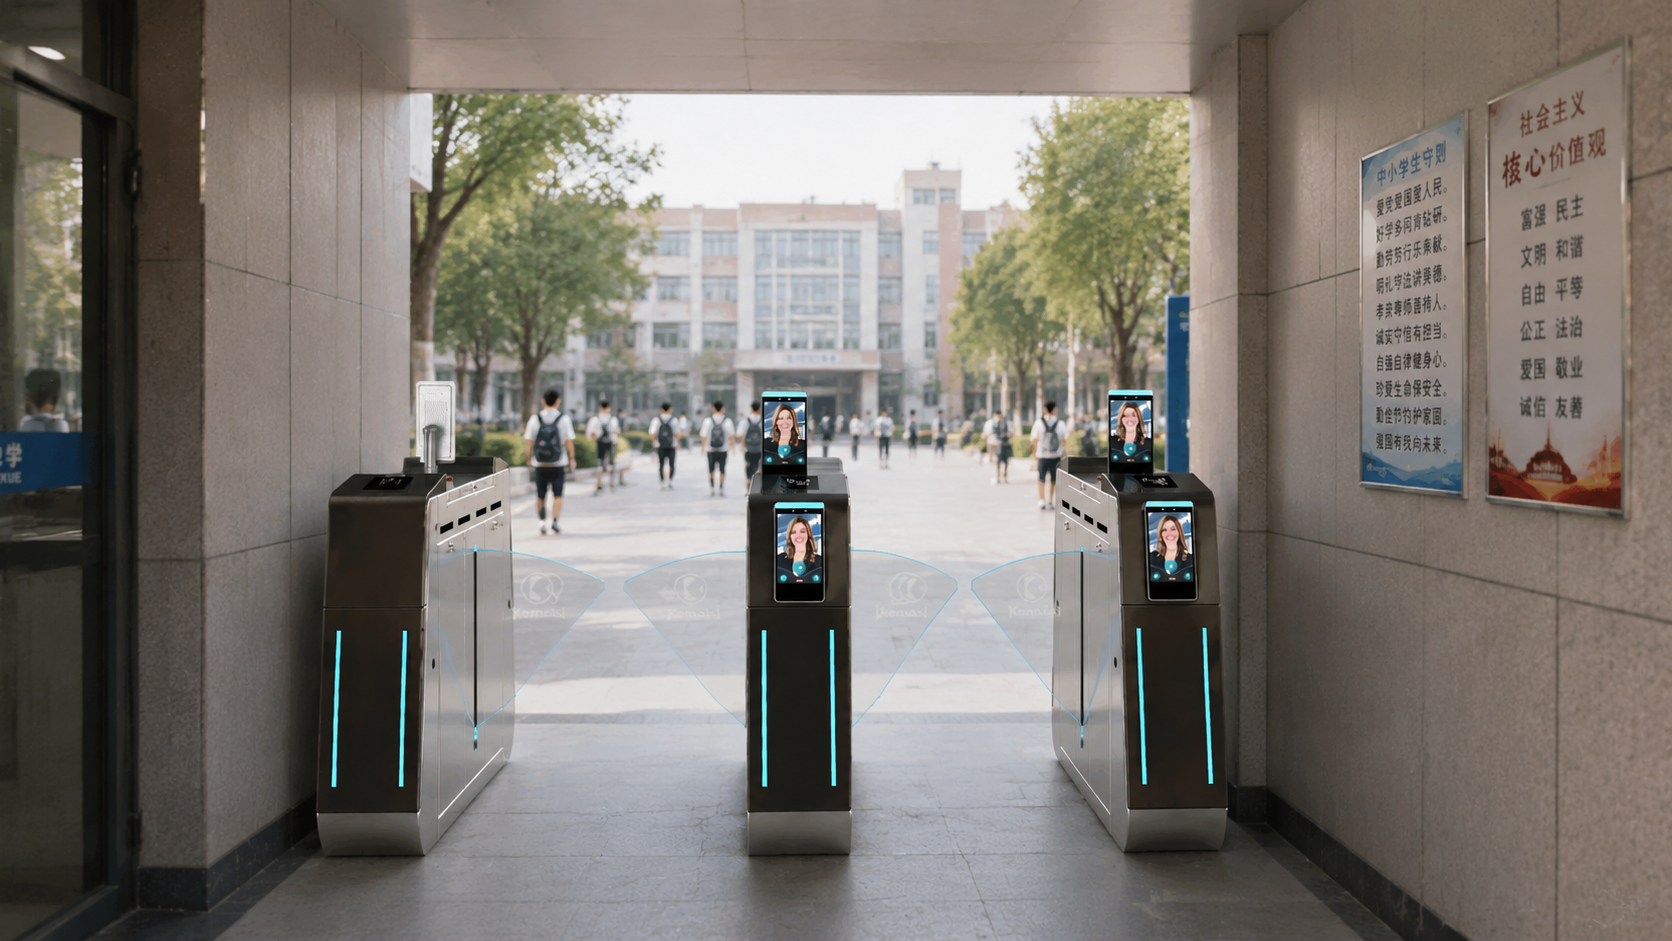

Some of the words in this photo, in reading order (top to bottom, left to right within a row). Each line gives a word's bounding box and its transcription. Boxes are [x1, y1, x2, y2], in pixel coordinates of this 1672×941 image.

[1519, 89, 1585, 138] 社会主义
[1377, 140, 1447, 187] 中小学生守则
[1521, 203, 1547, 232] 富强
[1555, 194, 1584, 223] 民主
[1521, 243, 1547, 269] 文明
[1555, 234, 1584, 261] 和谐
[1521, 281, 1546, 307] 自由
[1555, 275, 1584, 302] 平等
[1520, 320, 1546, 342] 公正
[1555, 315, 1583, 340] 法治
[1520, 358, 1546, 380] 爱国
[1555, 356, 1583, 379] 敬业
[1520, 396, 1546, 419] 诚信
[1555, 396, 1583, 420] 友善
[0, 441, 23, 469] 学
